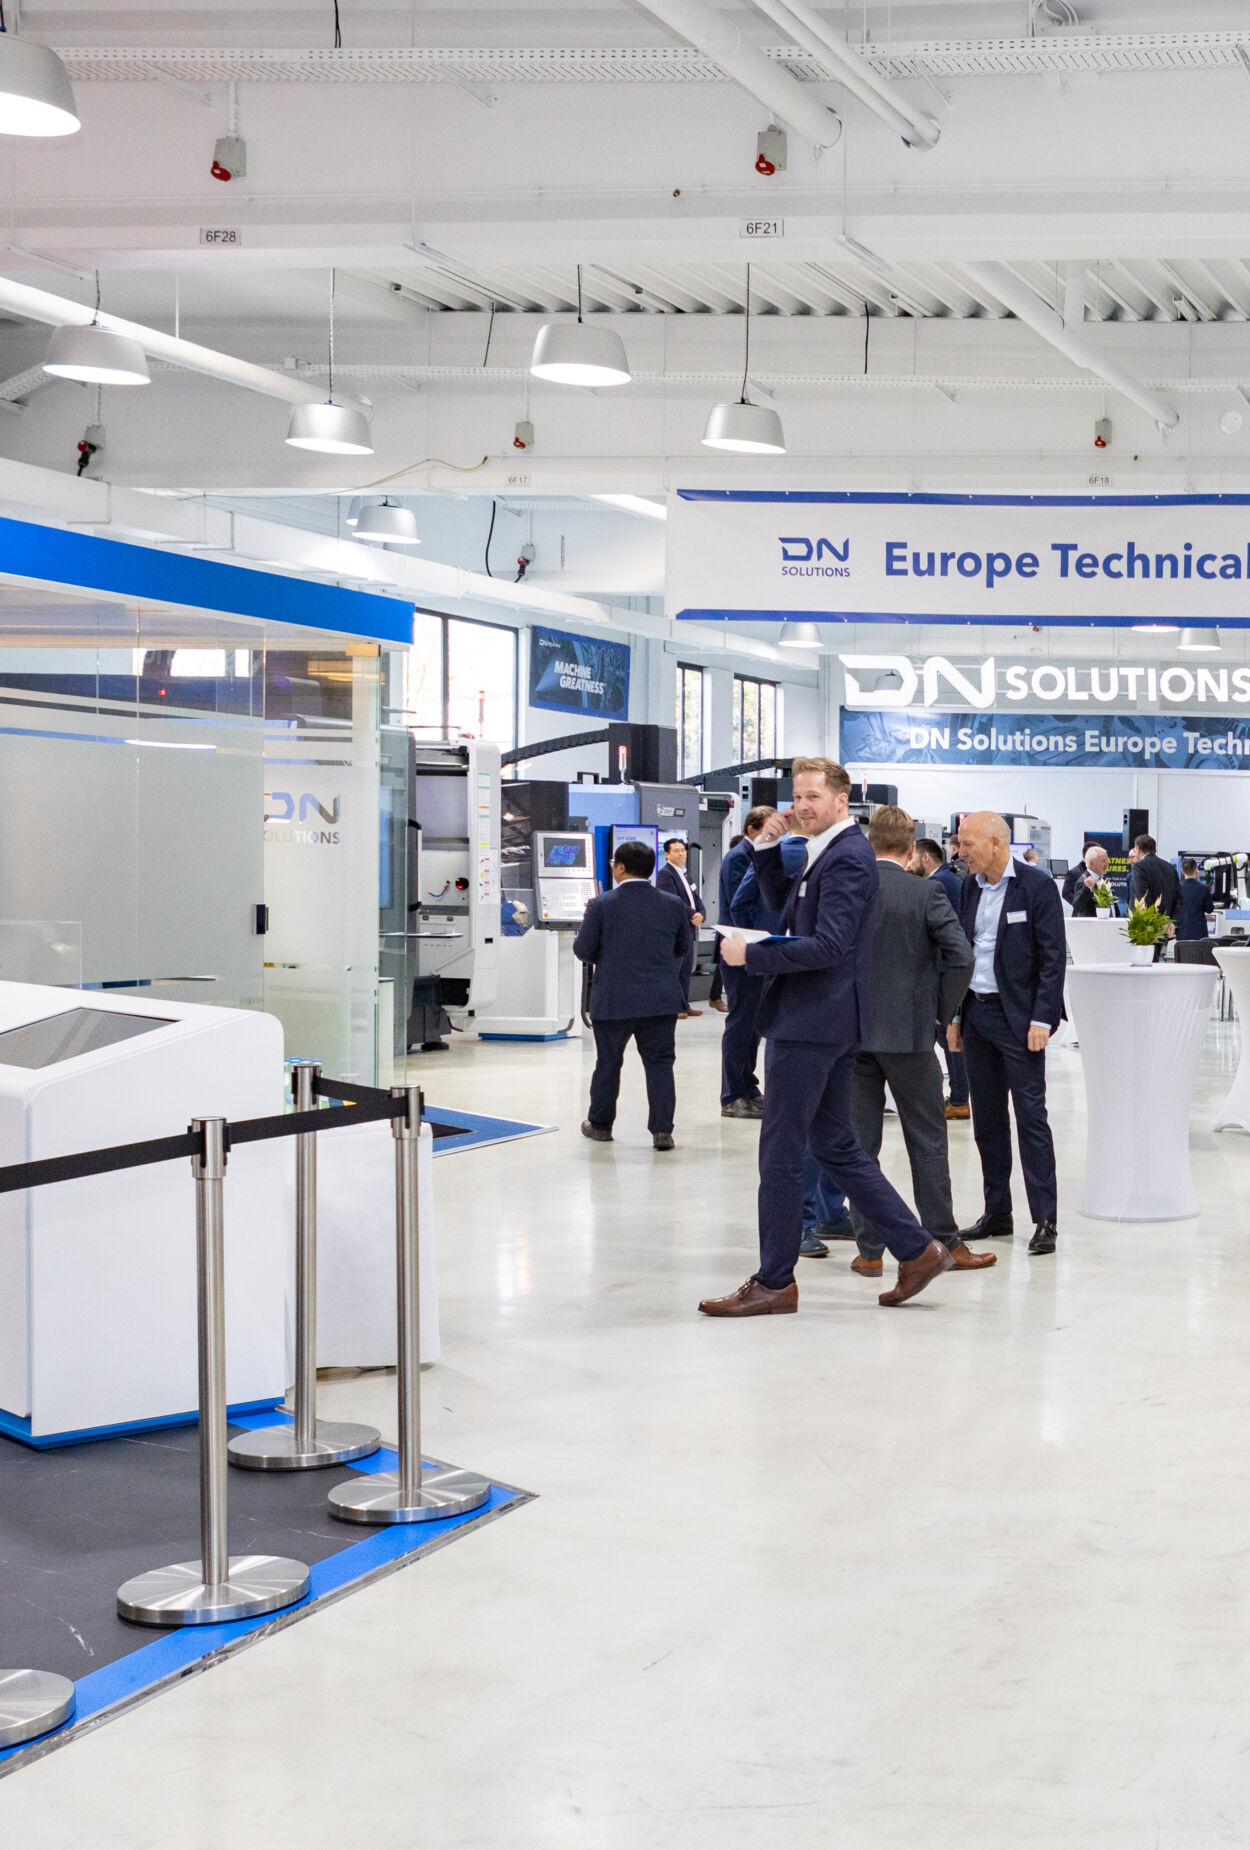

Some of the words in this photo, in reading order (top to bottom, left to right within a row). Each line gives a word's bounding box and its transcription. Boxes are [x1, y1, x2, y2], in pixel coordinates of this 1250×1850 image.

[205, 230, 236, 243] 6F28
[746, 222, 777, 235] 6F21
[508, 476, 528, 484] 6F17
[1089, 476, 1110, 485] 6F18
[778, 537, 850, 562] DN
[781, 566, 850, 577] SOLUTIONS
[885, 541, 1040, 589] Europe
[554, 661, 592, 679] MACHINE
[560, 675, 605, 695] GREATNESS
[838, 654, 996, 708] DN
[909, 726, 951, 751] DN
[957, 727, 1077, 752] Solutions
[1085, 730, 1177, 760] Europe
[264, 830, 341, 845] OLUTIONS
